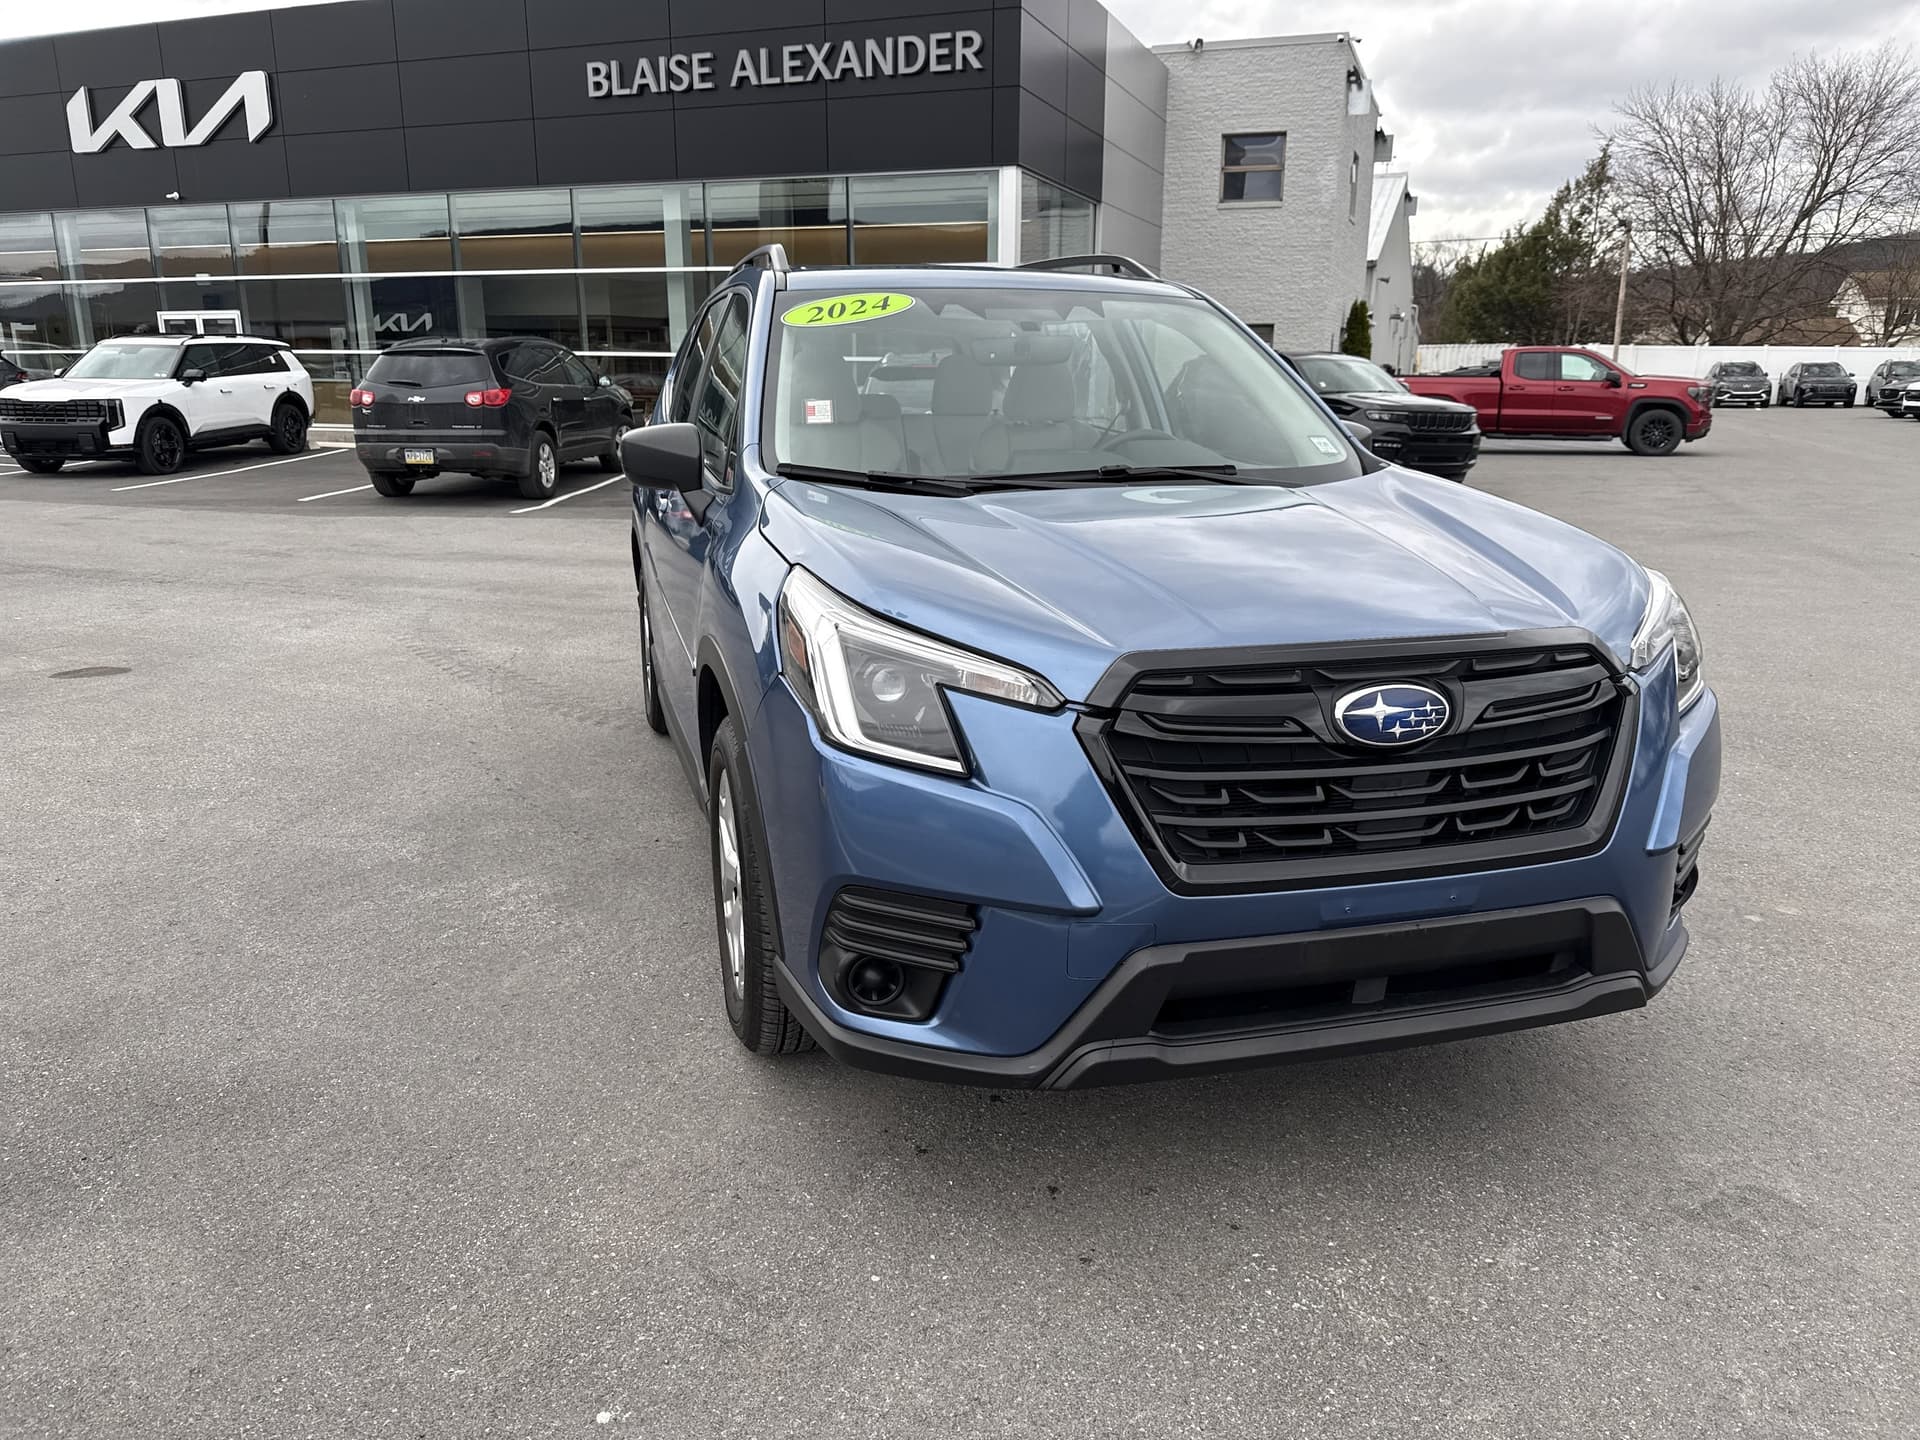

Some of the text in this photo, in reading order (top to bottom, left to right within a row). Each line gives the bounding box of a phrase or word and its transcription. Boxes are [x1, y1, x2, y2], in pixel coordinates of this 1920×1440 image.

[586, 30, 984, 98] BLAISE ALEXANDER
[66, 70, 273, 153] KIA
[373, 312, 432, 332] KIA
[806, 295, 891, 324] 2024
